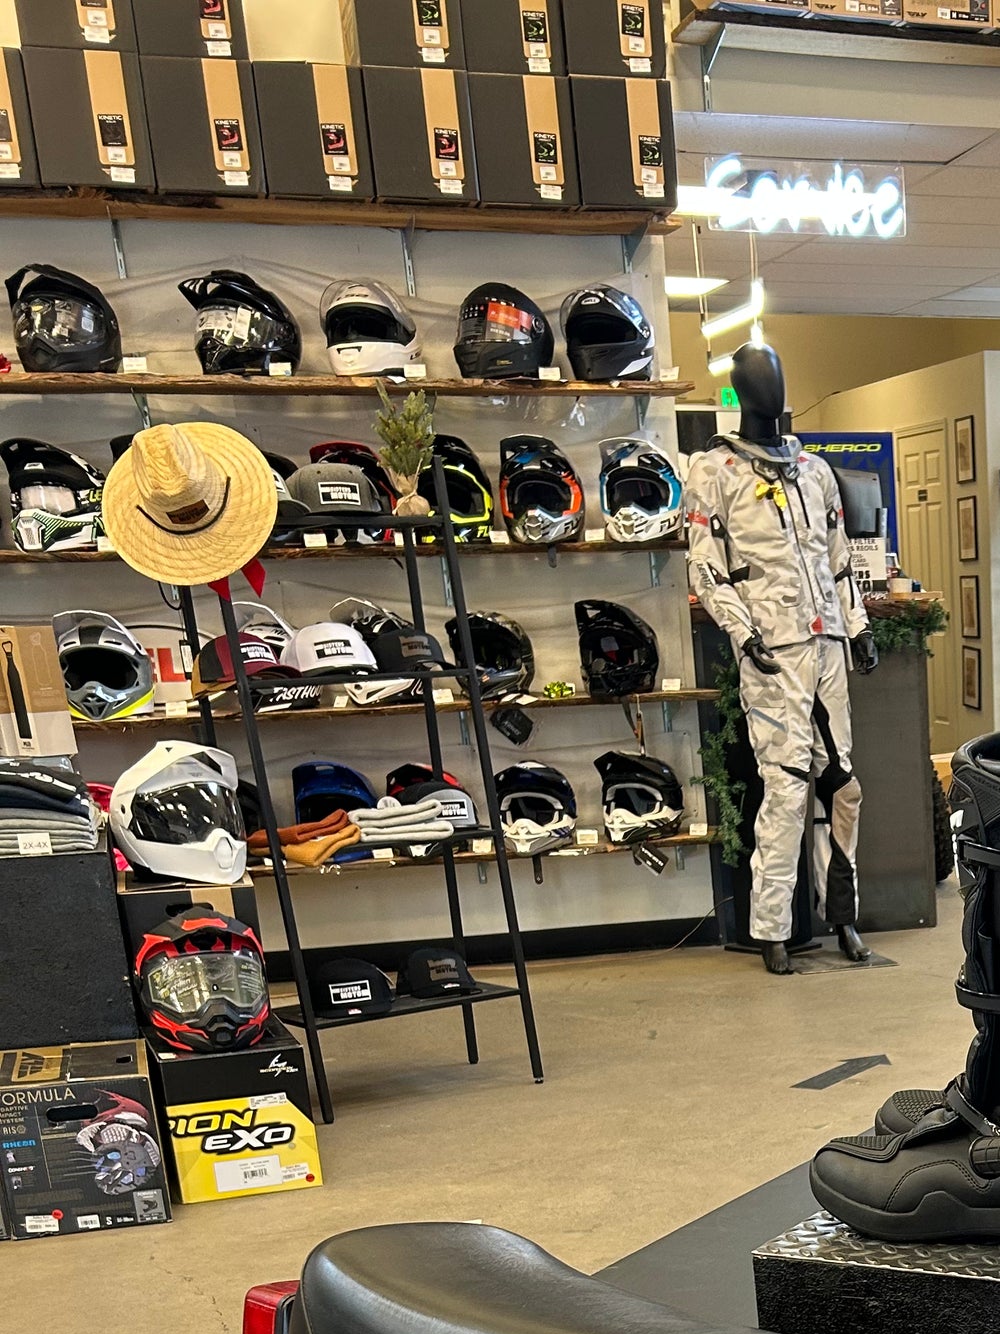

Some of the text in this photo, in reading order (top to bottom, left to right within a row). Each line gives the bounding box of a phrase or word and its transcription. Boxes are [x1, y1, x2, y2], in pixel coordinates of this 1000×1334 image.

[622, 4, 643, 13] KINETIC
[522, 11, 545, 19] KINETIC
[435, 128, 458, 136] KINETIC
[534, 132, 555, 140] KINETIC
[804, 443, 882, 453] SHERCO
[23, 842, 48, 850] 2X-4X
[0, 1087, 76, 1106] ORMULA
[0, 1105, 28, 1113] DAPTIVE
[106, 1216, 113, 1226] S
